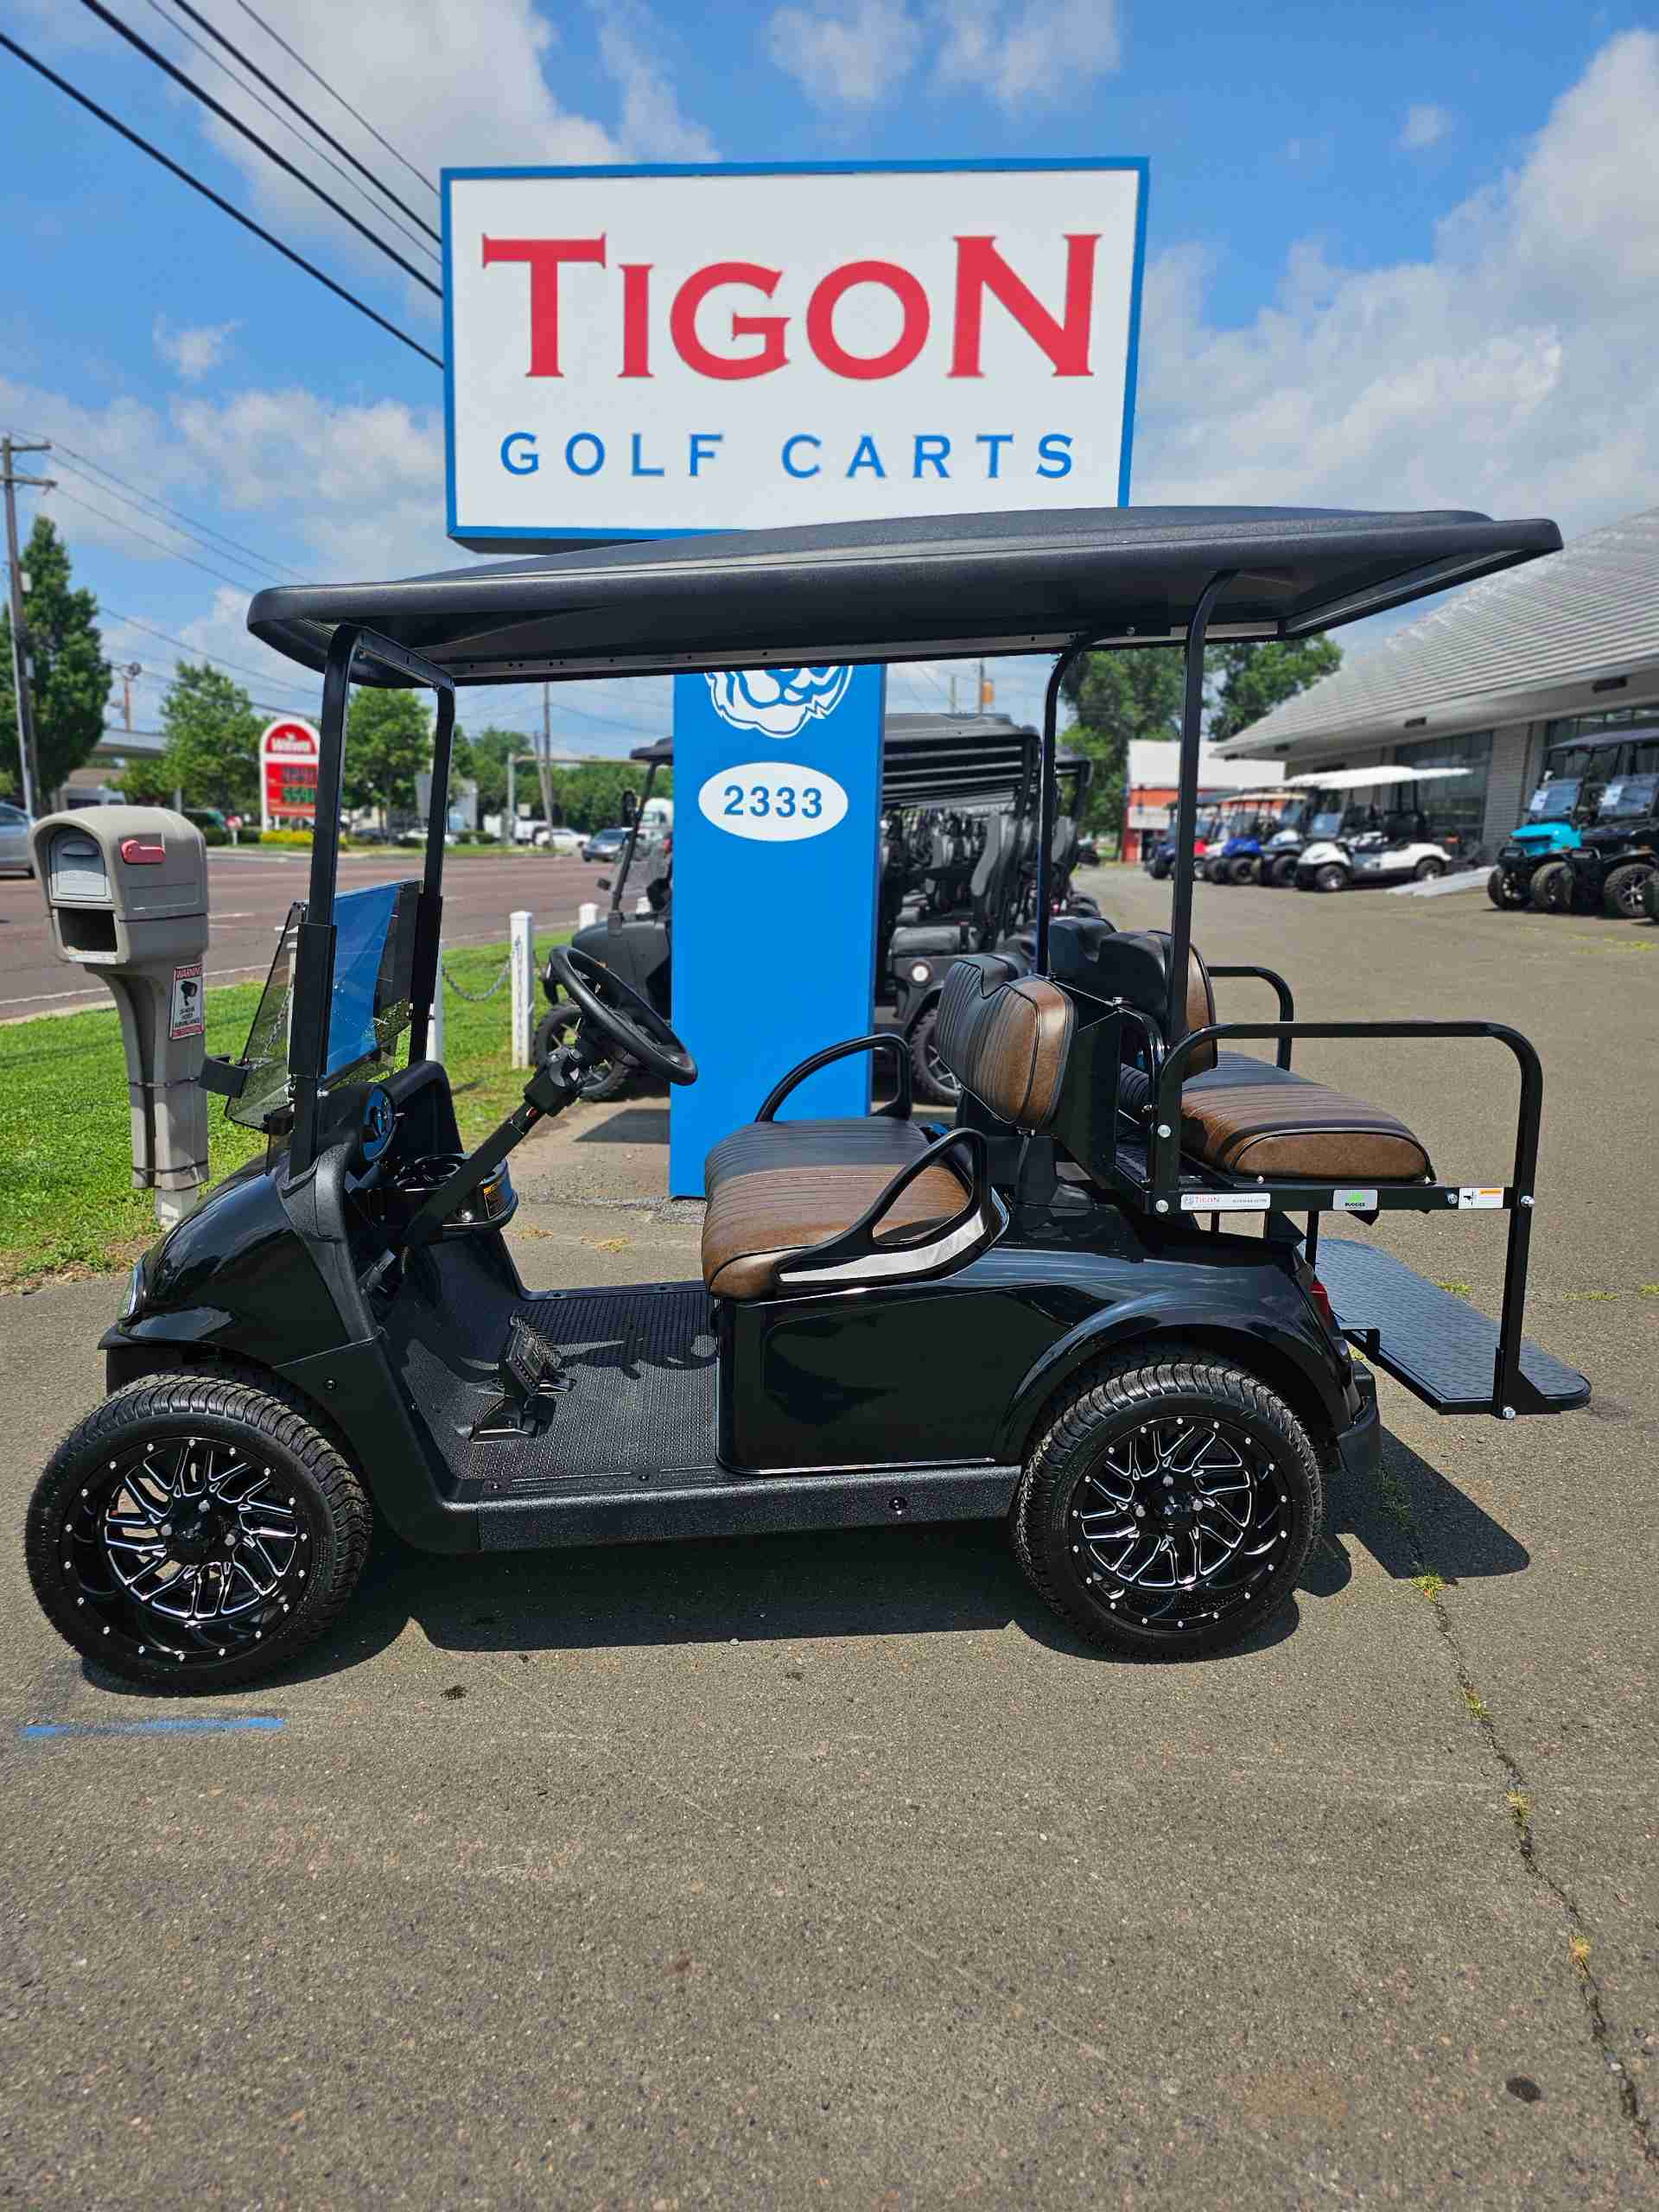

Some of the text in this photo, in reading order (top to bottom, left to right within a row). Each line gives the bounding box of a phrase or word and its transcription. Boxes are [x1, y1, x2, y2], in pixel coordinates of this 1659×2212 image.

[481, 232, 1103, 381] TIGON
[499, 430, 1074, 479] GOLF CARTS
[723, 785, 823, 819] 2333
